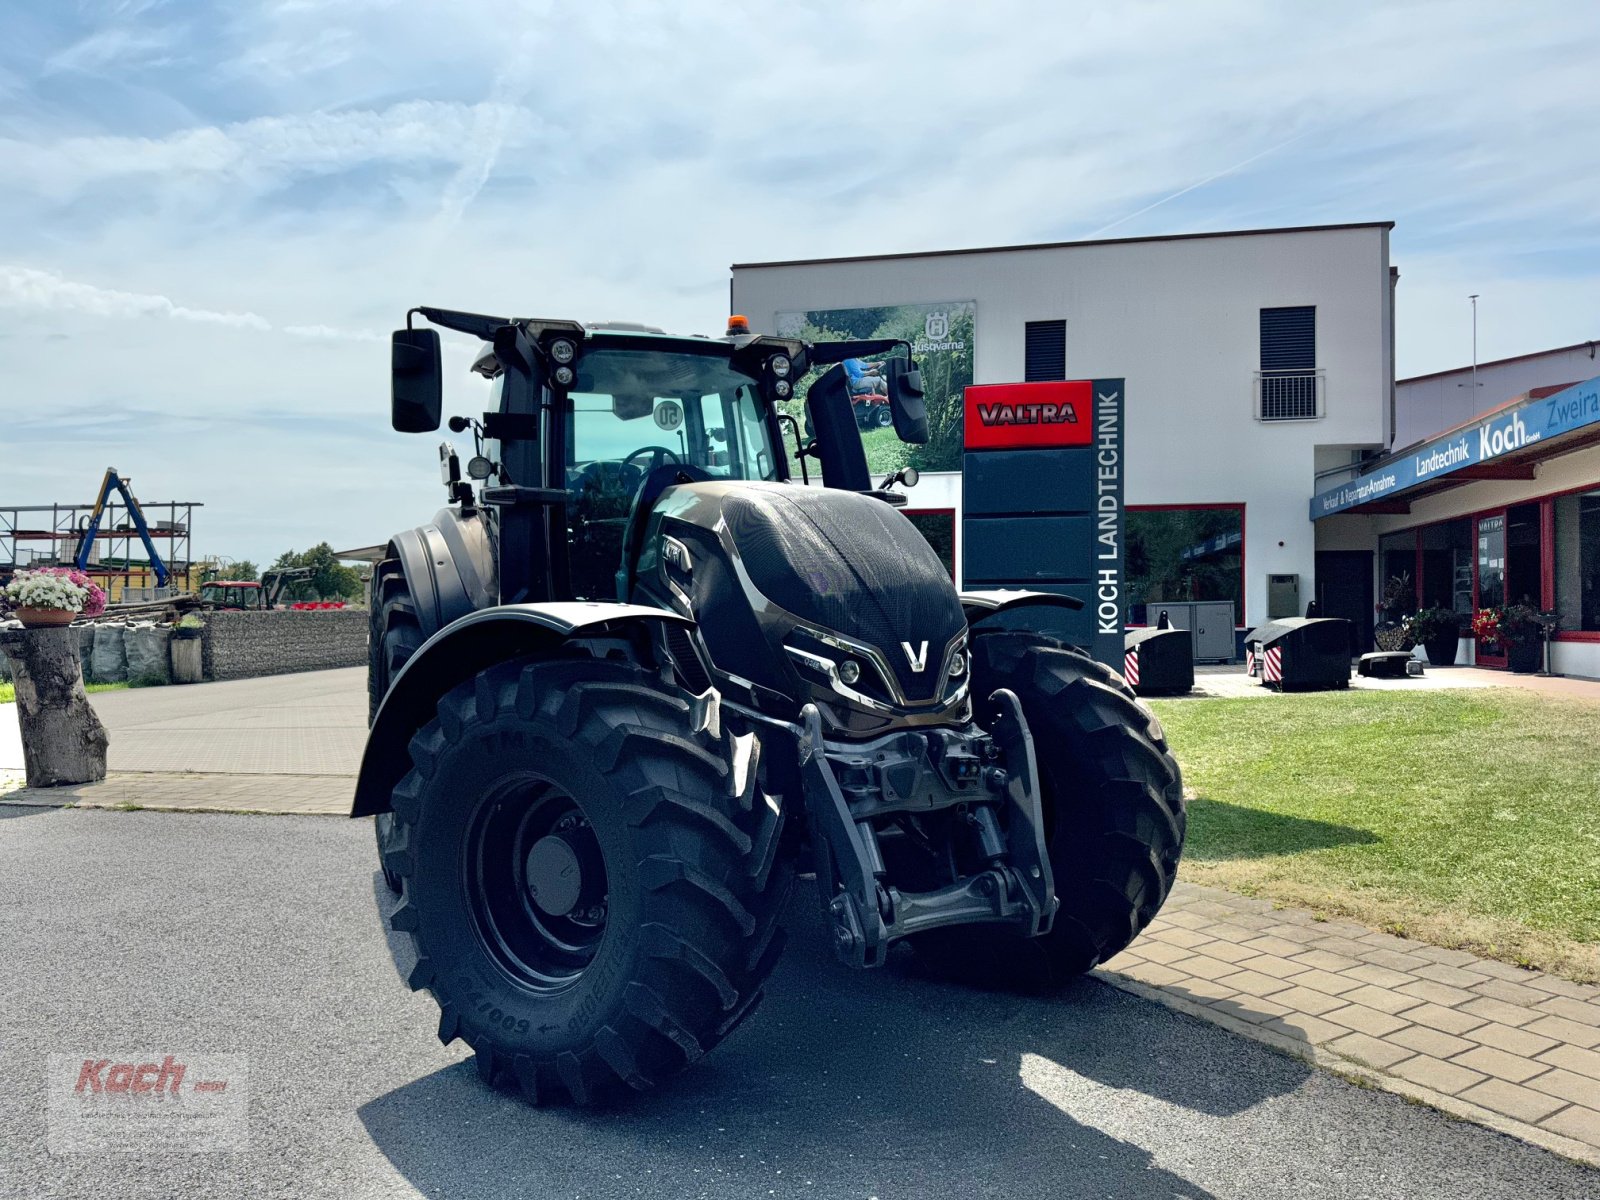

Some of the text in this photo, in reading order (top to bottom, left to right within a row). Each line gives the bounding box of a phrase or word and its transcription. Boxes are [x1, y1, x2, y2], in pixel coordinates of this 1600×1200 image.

[911, 341, 964, 353] Husqvarna
[977, 402, 1079, 427] VALTRA
[1546, 391, 1600, 429] Zweira
[1416, 437, 1469, 477] Landtechnik
[1479, 412, 1526, 460] Koch
[1098, 391, 1118, 634] KOCH LANDTECHNIK
[1323, 492, 1339, 510] Verkauf
[1340, 490, 1345, 505] &
